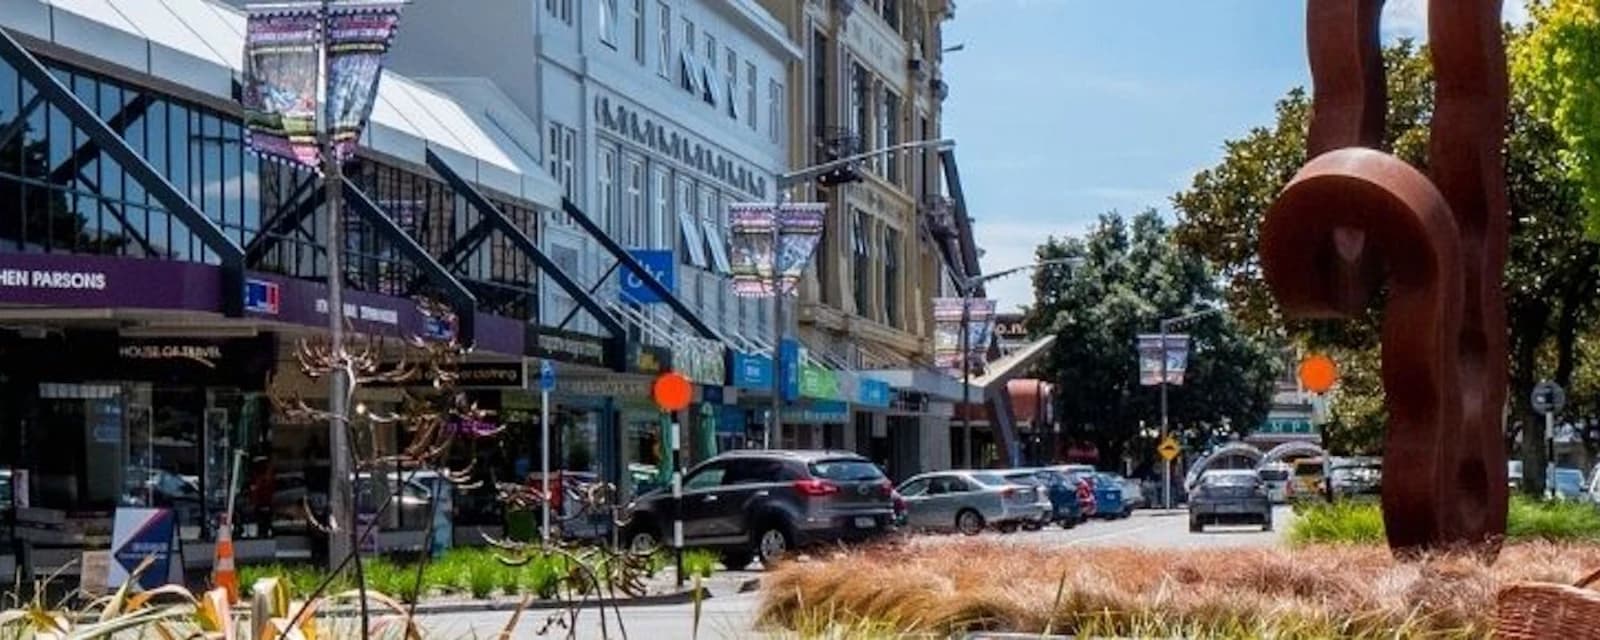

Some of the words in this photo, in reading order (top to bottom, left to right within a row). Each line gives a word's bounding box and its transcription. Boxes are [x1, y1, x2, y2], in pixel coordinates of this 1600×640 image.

[32, 270, 106, 290] PARSONS
[119, 345, 160, 359] HOUSE
[181, 345, 222, 360] TRAVEL
